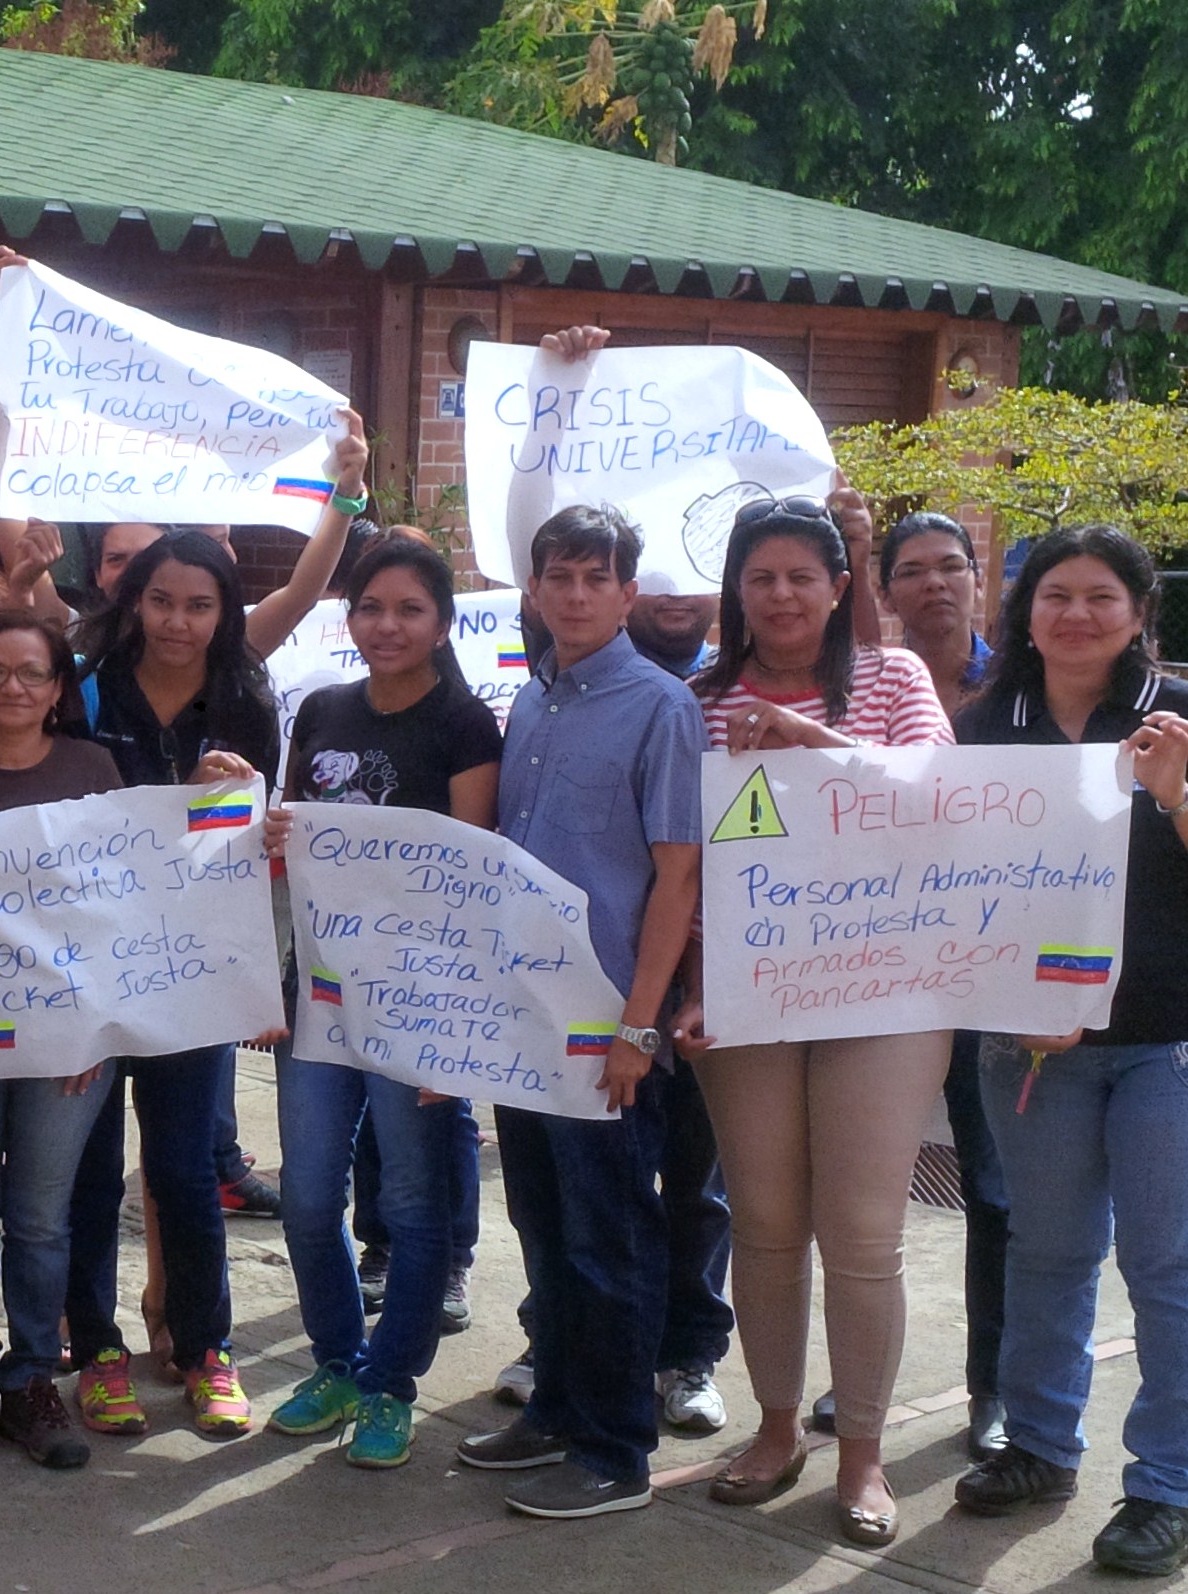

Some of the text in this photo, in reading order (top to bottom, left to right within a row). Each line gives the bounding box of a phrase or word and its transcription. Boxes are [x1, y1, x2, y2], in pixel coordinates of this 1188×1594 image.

[26, 339, 166, 383] Protesta
[494, 381, 672, 432] CRISIS
[153, 465, 188, 495] el
[458, 609, 497, 640] NO
[737, 850, 1117, 909] Personal Administrativo
[812, 905, 958, 947] Protesta
[53, 931, 95, 966] de
[326, 1024, 346, 1048] a
